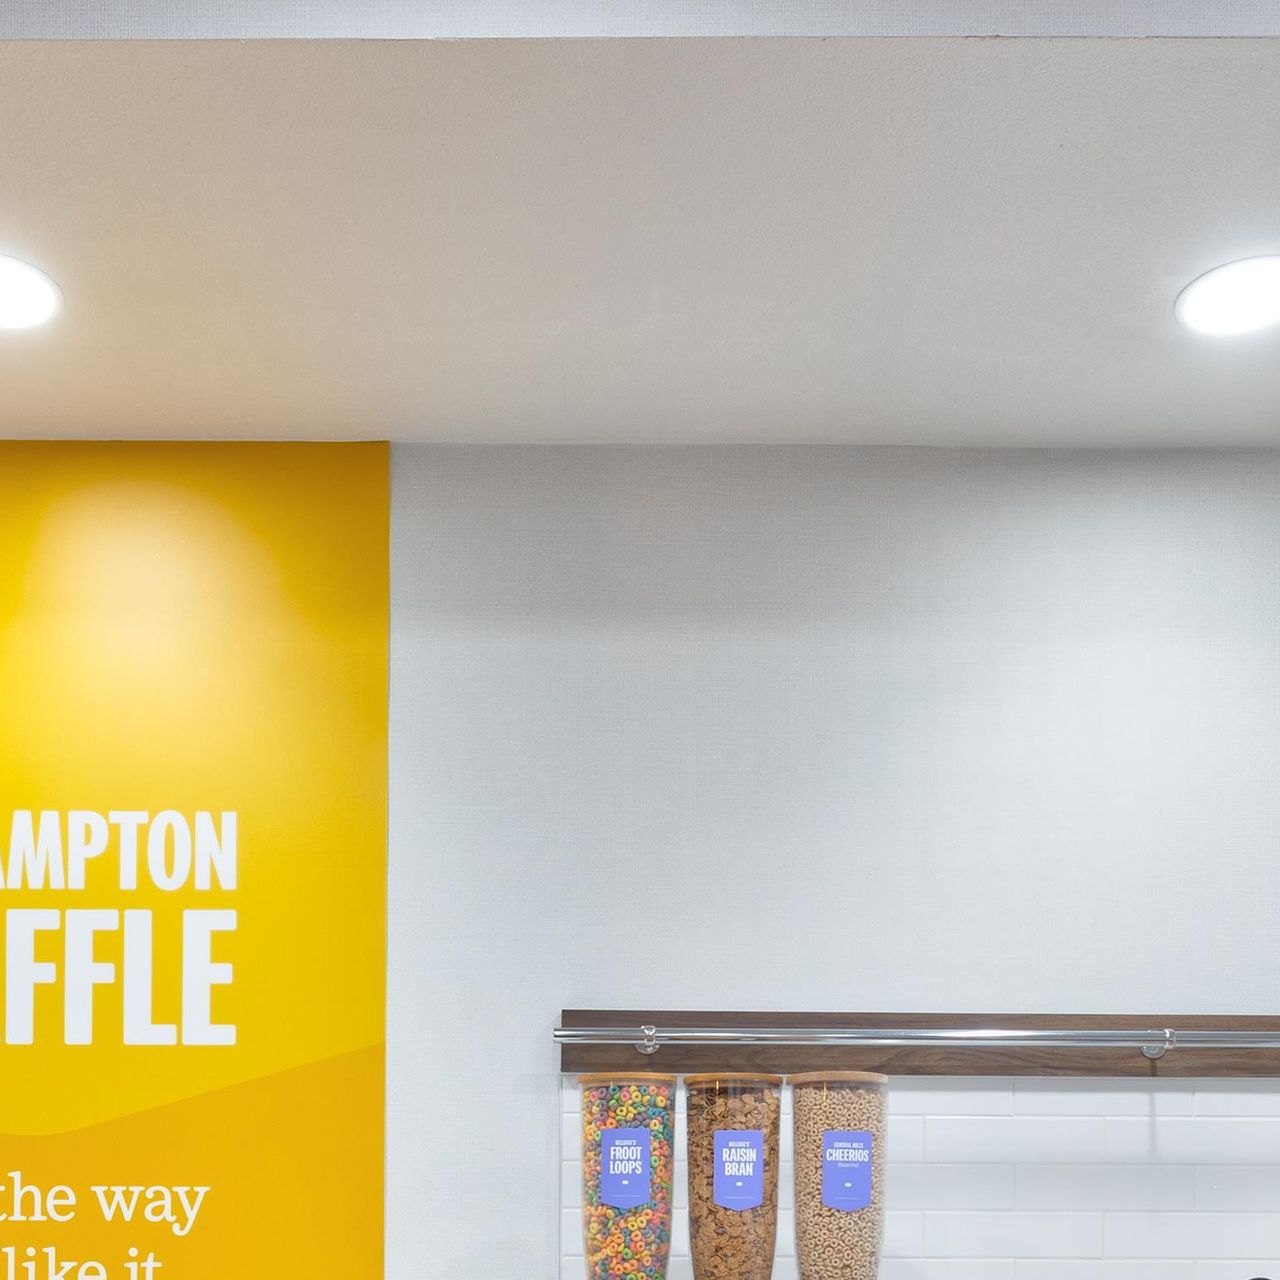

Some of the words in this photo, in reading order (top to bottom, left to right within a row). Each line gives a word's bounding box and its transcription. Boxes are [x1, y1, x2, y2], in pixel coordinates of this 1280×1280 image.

[610, 1146, 642, 1160] FROOT
[722, 1148, 757, 1162] RAISIN
[826, 1149, 869, 1162] CHEERIOS
[609, 1160, 642, 1175] LOOPS
[724, 1162, 753, 1176] BRAN
[90, 1186, 210, 1236] way
